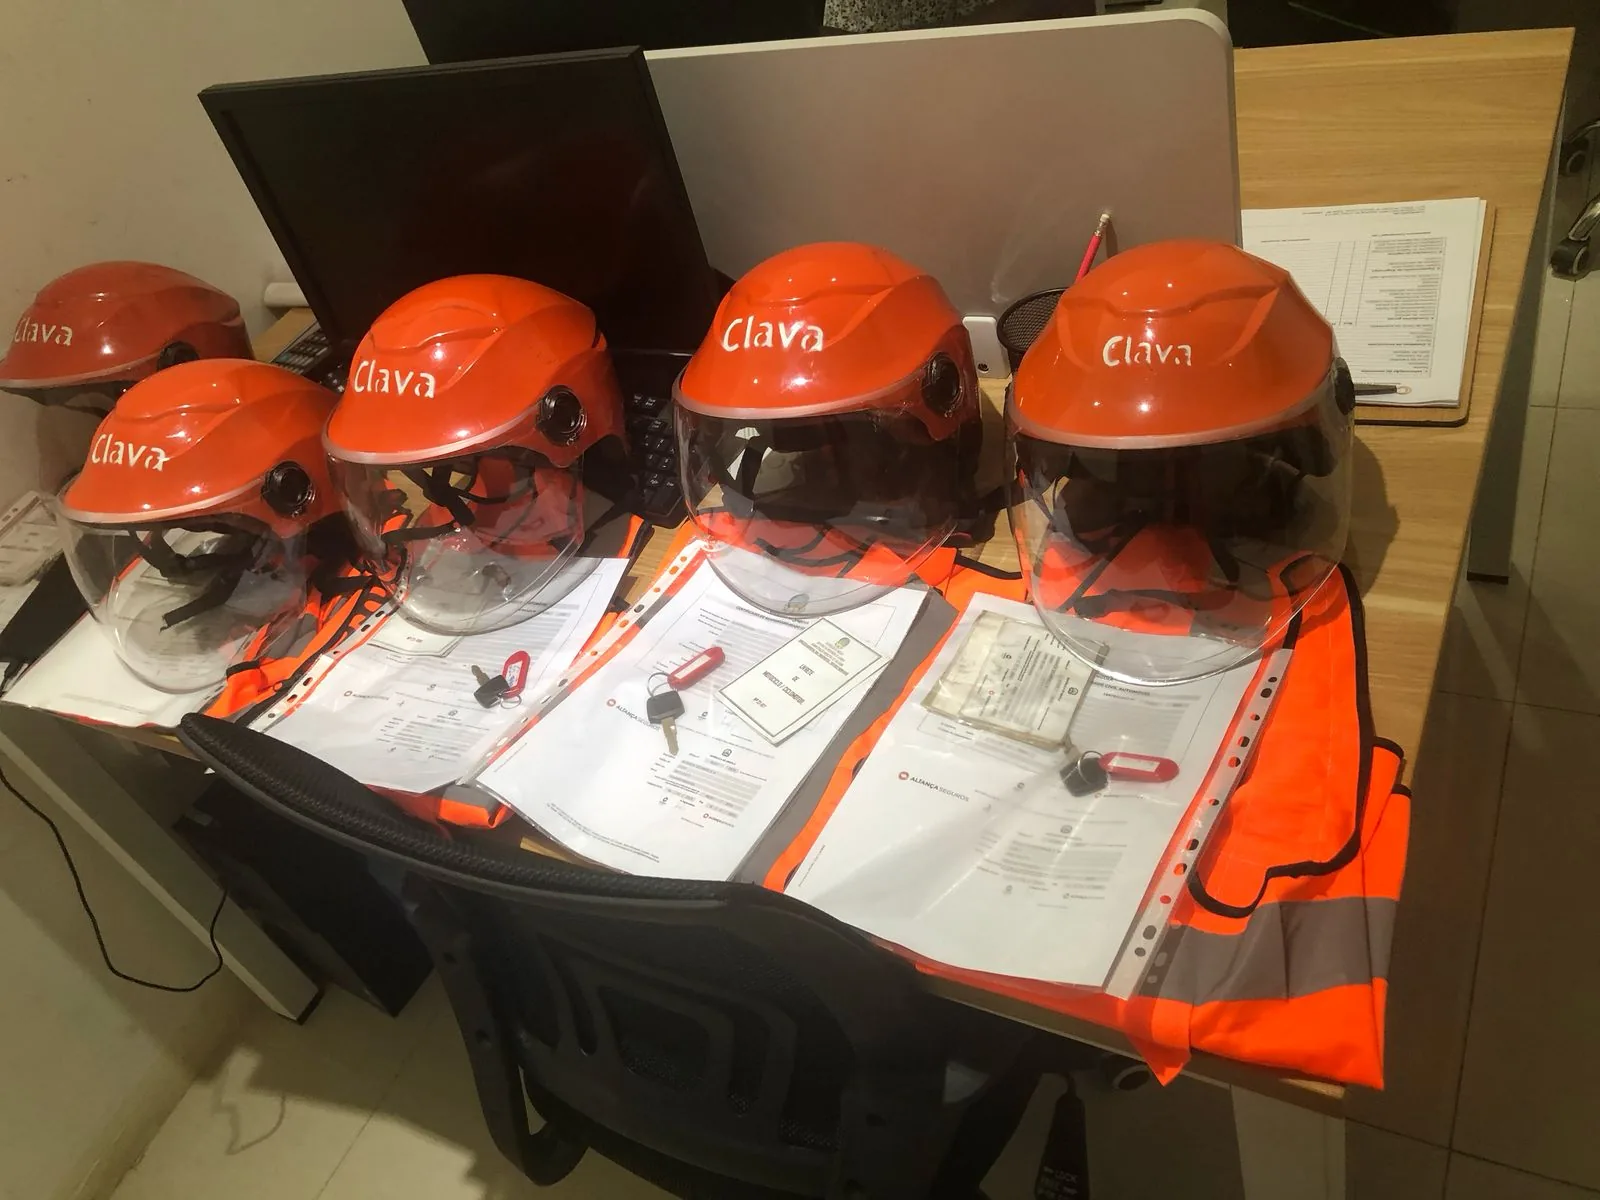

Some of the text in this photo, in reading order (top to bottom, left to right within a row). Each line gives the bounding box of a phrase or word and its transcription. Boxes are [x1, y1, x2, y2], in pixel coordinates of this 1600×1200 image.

[14, 316, 73, 347] Clava
[722, 315, 824, 352] Clava
[1102, 335, 1192, 367] Clava
[354, 359, 436, 399] Clava
[91, 433, 168, 471] Clava
